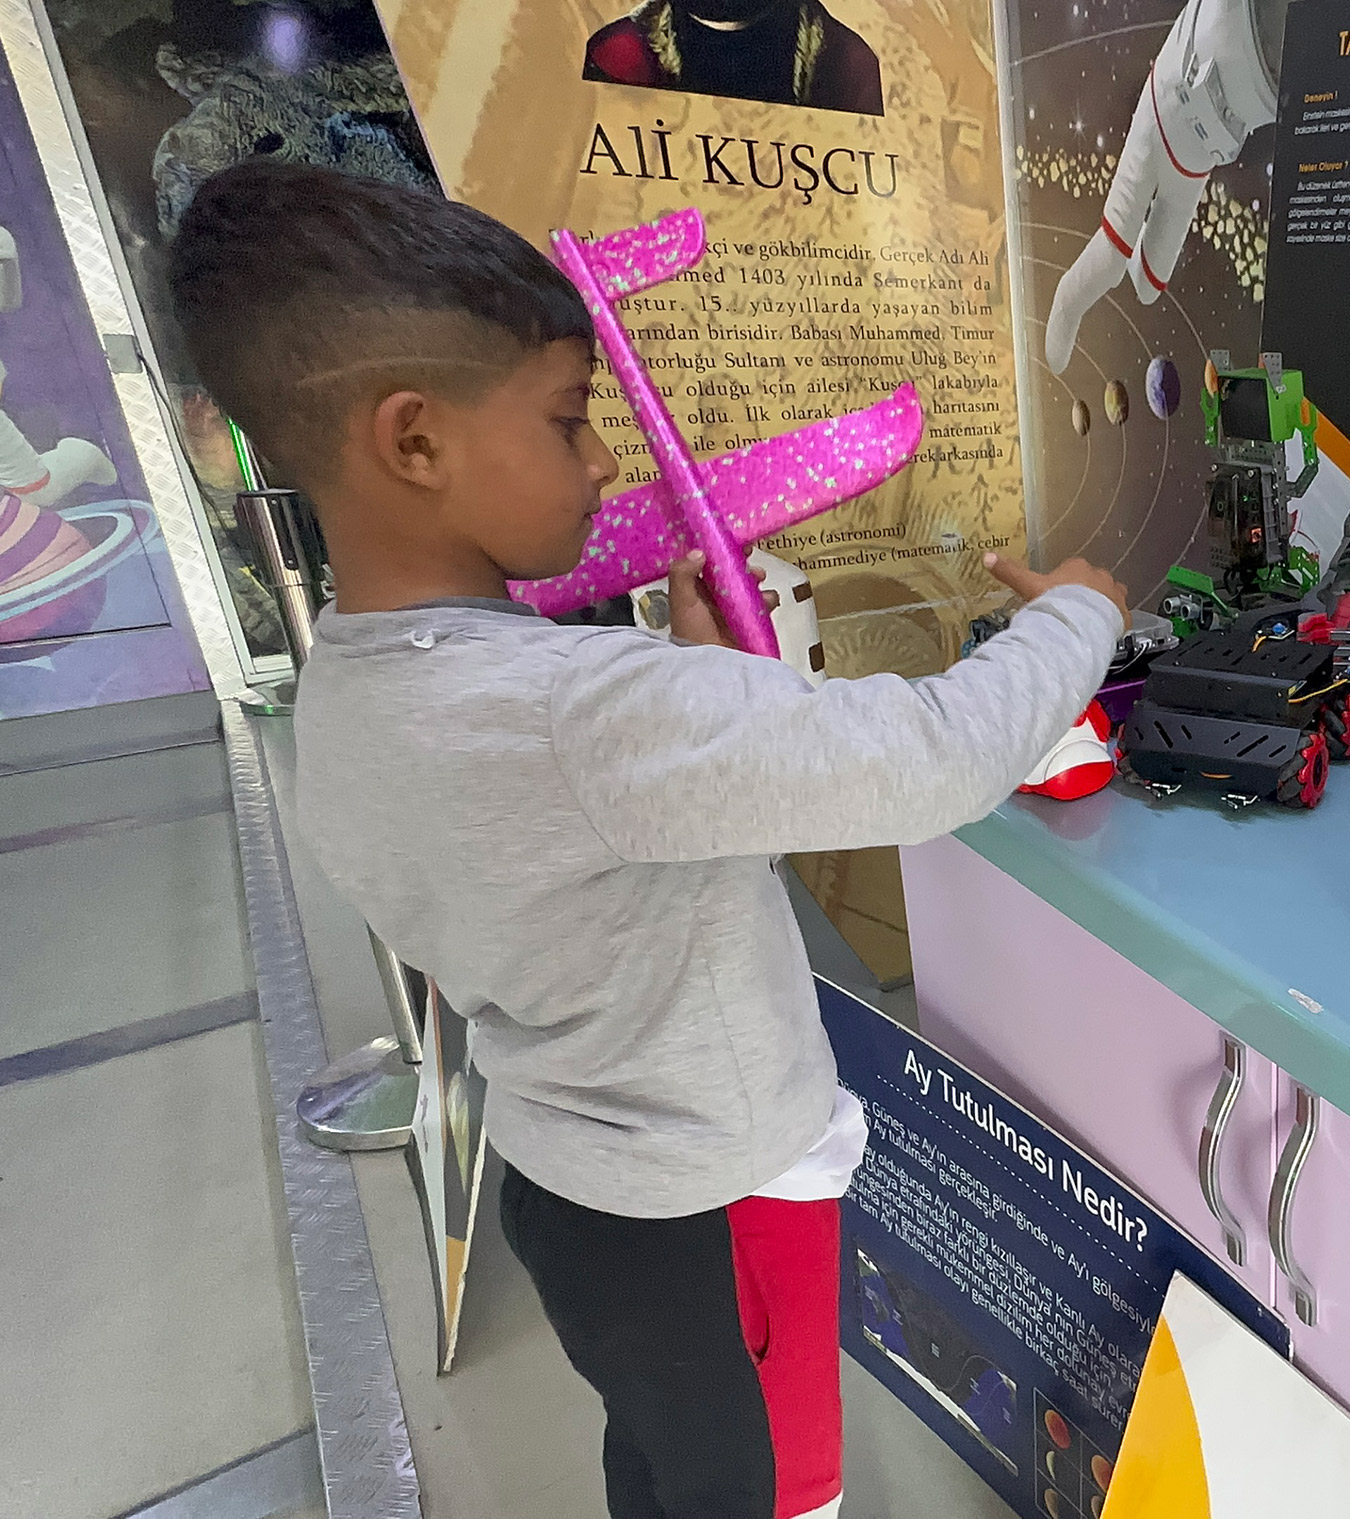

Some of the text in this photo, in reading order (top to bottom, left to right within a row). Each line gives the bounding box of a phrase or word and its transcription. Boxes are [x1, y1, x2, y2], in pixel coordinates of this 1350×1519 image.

[695, 134, 899, 205] KUŞCU
[733, 243, 754, 256] ve
[880, 245, 934, 266] Gerçek
[939, 250, 963, 265] Adı
[969, 250, 989, 265] Ali
[740, 268, 990, 291] 1403 yılında Semerkant da
[750, 297, 860, 317] yüzyıllarda
[873, 303, 939, 318] yaşayan
[951, 301, 992, 315] bilim
[708, 324, 782, 340] birisidir.
[792, 325, 842, 340] Babası
[951, 326, 994, 340] Timur
[795, 355, 813, 366] ve
[822, 354, 903, 366] astronomu
[912, 351, 947, 369] Uluğ
[687, 375, 998, 400] olduğu için ailesi lakabıyla
[688, 400, 999, 424] oldu. İlk olarak haritasını
[694, 423, 1002, 452] ile matematik
[939, 445, 1003, 462] arkasında
[820, 523, 907, 548] (astronomi)
[978, 535, 1010, 549] cebir
[904, 1049, 1147, 1252] Ay Tutulması Nedir?
[872, 1102, 905, 1138] Güneş
[908, 1129, 920, 1145] ve
[950, 1161, 989, 1198] arasına
[993, 1194, 1048, 1246] girdiğinde
[1051, 1240, 1065, 1260] ve
[874, 1120, 998, 1222] Ay tutulması gerçekleşir.
[878, 1153, 932, 1201] olduğunda
[961, 1217, 989, 1248] rengi
[1039, 1281, 1053, 1298] ve
[1056, 1293, 1085, 1329] Kanlı
[972, 1288, 1087, 1399] genellikle birkaç saat
